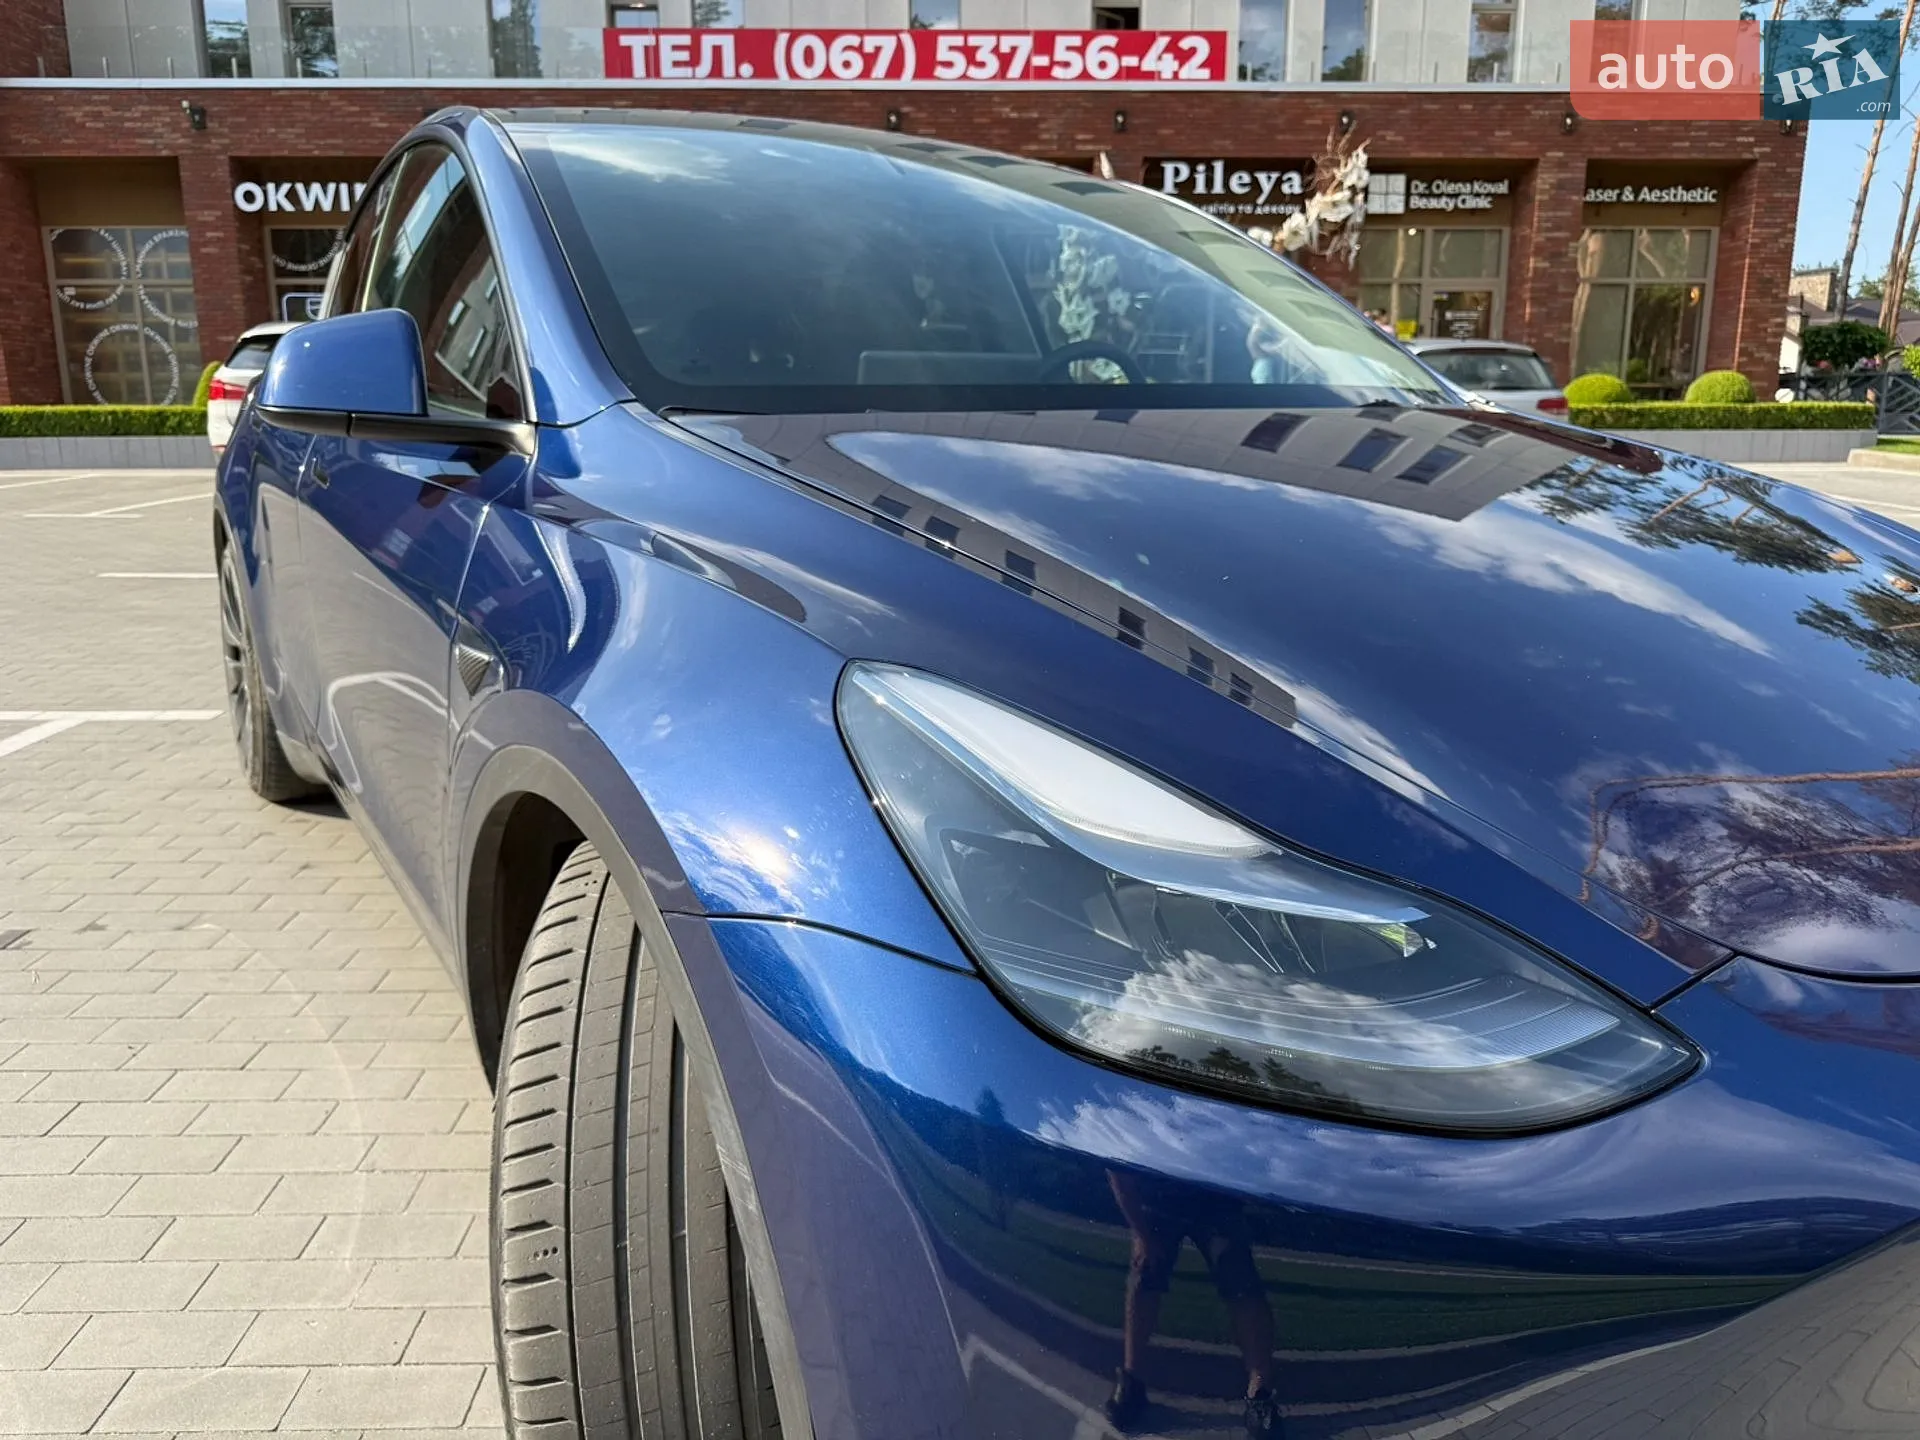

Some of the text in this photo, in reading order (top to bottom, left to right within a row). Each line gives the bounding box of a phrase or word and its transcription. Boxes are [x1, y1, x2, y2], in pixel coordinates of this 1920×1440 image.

[618, 32, 1212, 81] ТЕЛ. (067) 537-56-42
[1160, 159, 1303, 205] Pileya
[1410, 179, 1510, 194] Dr. Olena Koval
[1584, 184, 1718, 203] aser & Aesthetic
[1409, 196, 1493, 212] Beauty Clinic
